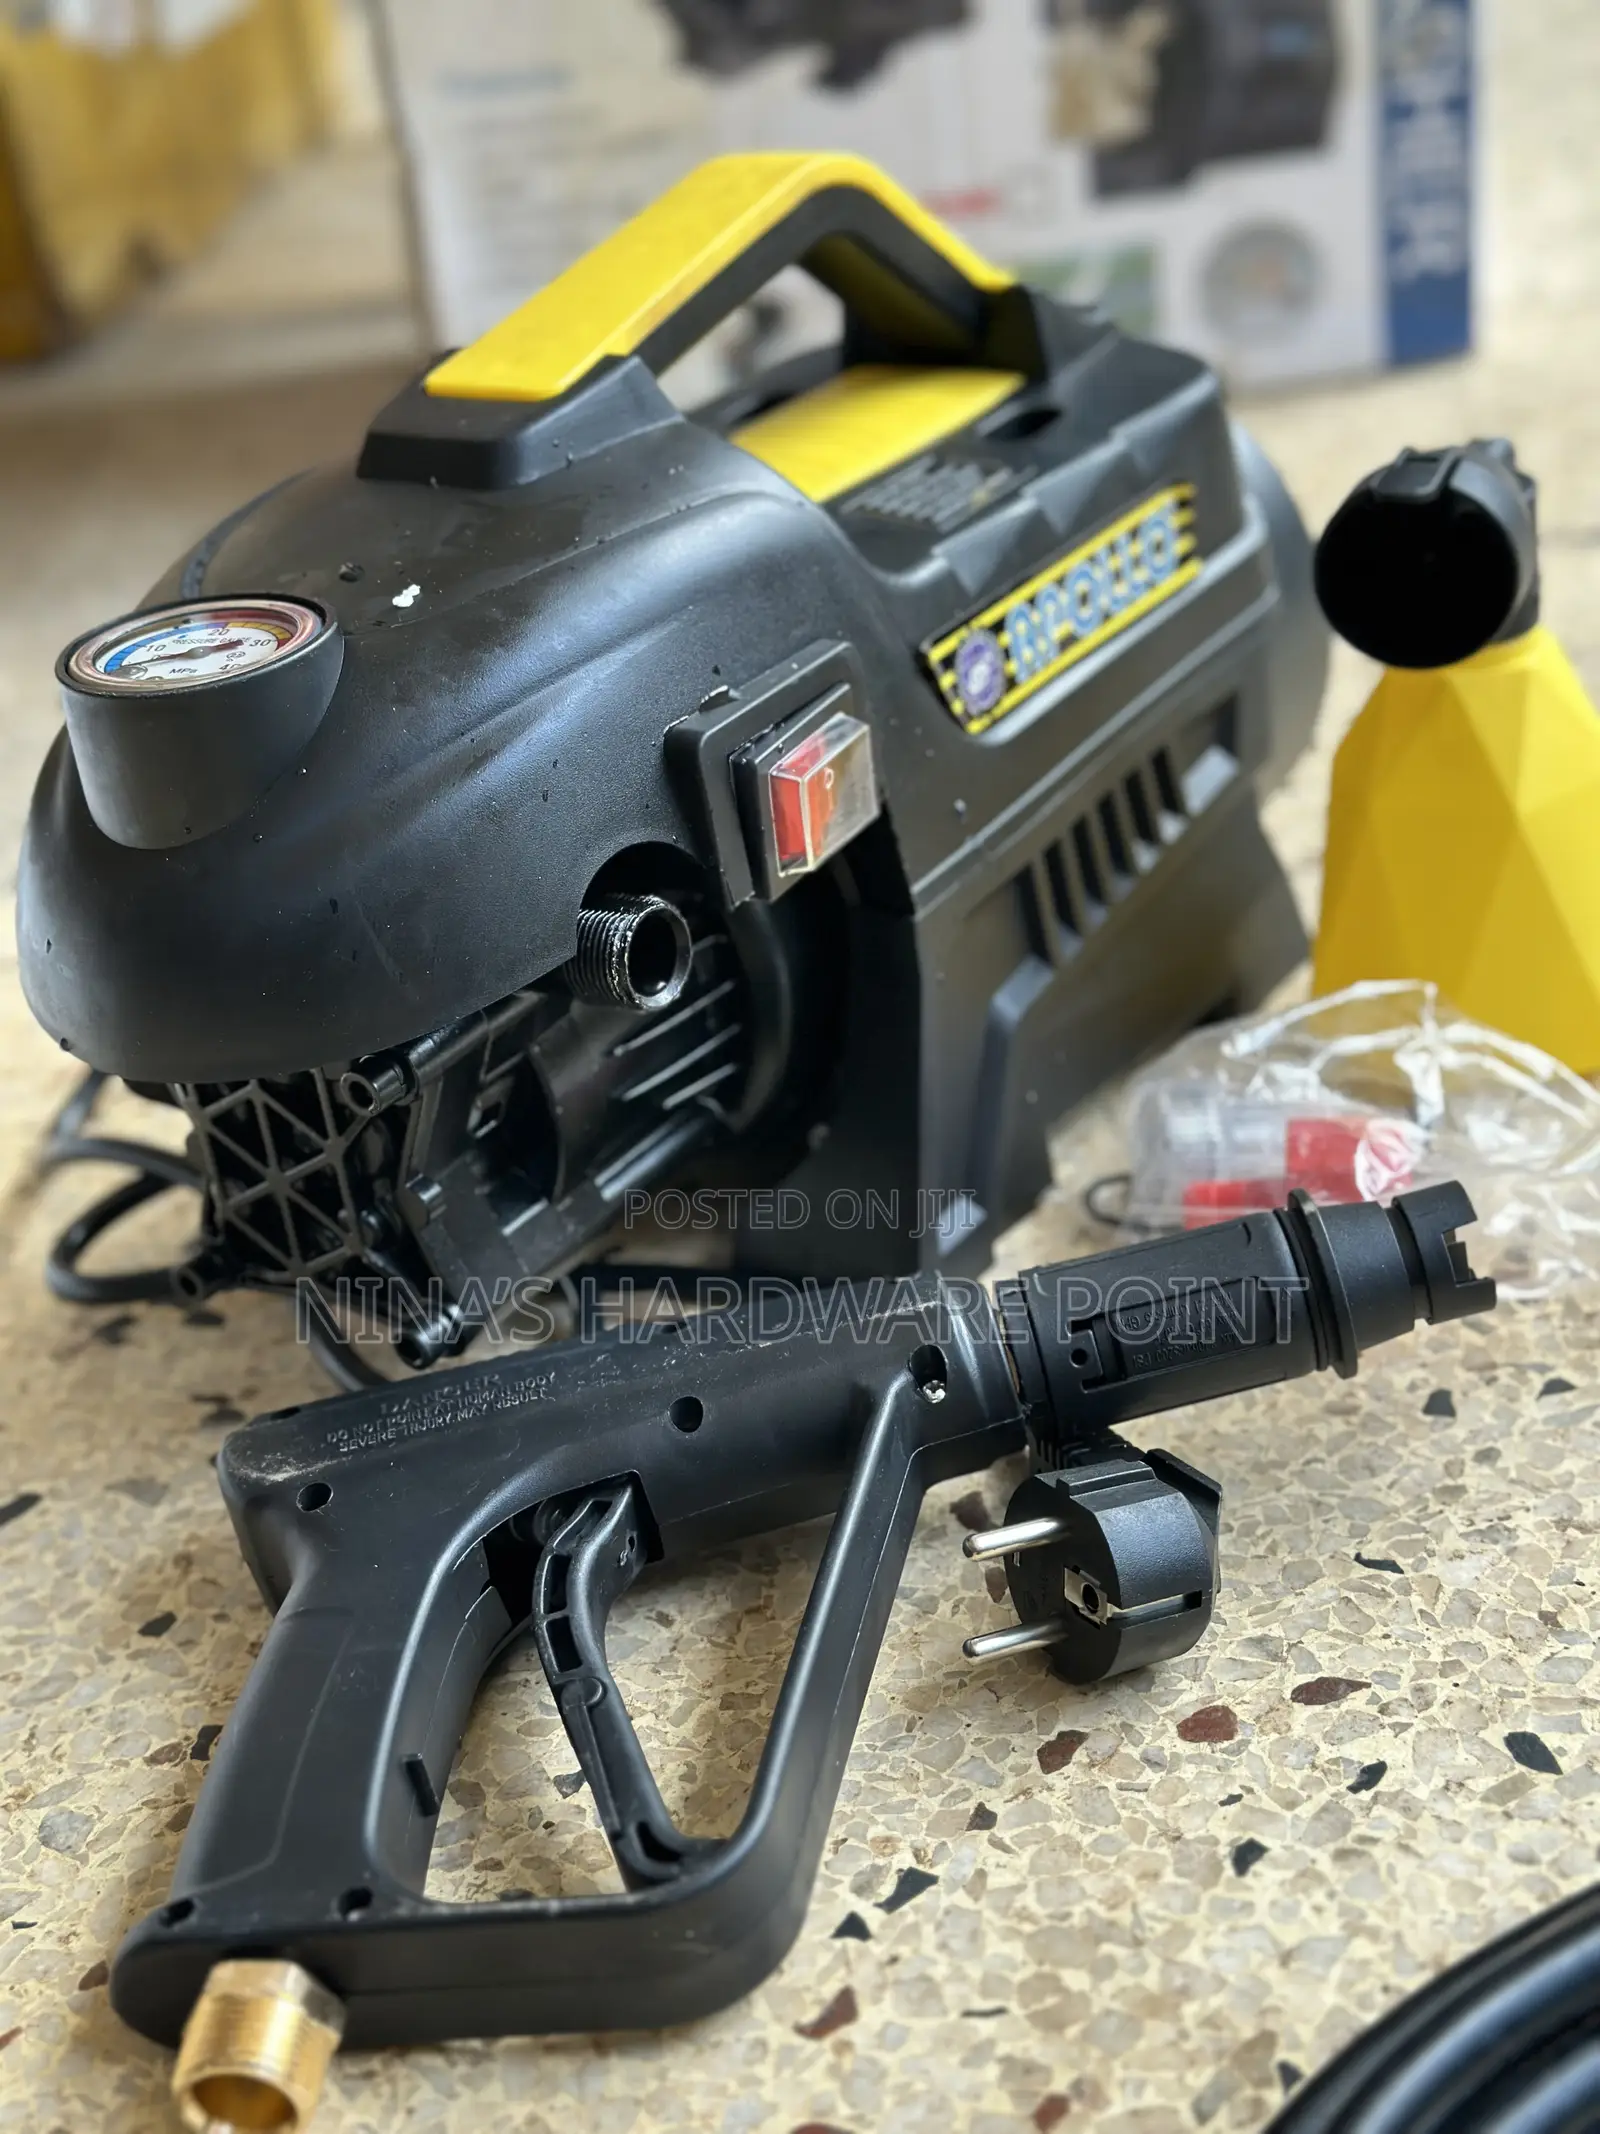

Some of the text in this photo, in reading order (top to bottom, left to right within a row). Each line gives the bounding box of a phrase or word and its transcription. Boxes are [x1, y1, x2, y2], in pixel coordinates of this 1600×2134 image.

[207, 628, 230, 636] 20
[220, 636, 250, 644] GAUE
[248, 639, 272, 647] 30
[146, 644, 167, 652] 10
[515, 1371, 556, 1392] BODY
[338, 1428, 397, 1452] SEVERE
[457, 1403, 488, 1421] MAY
